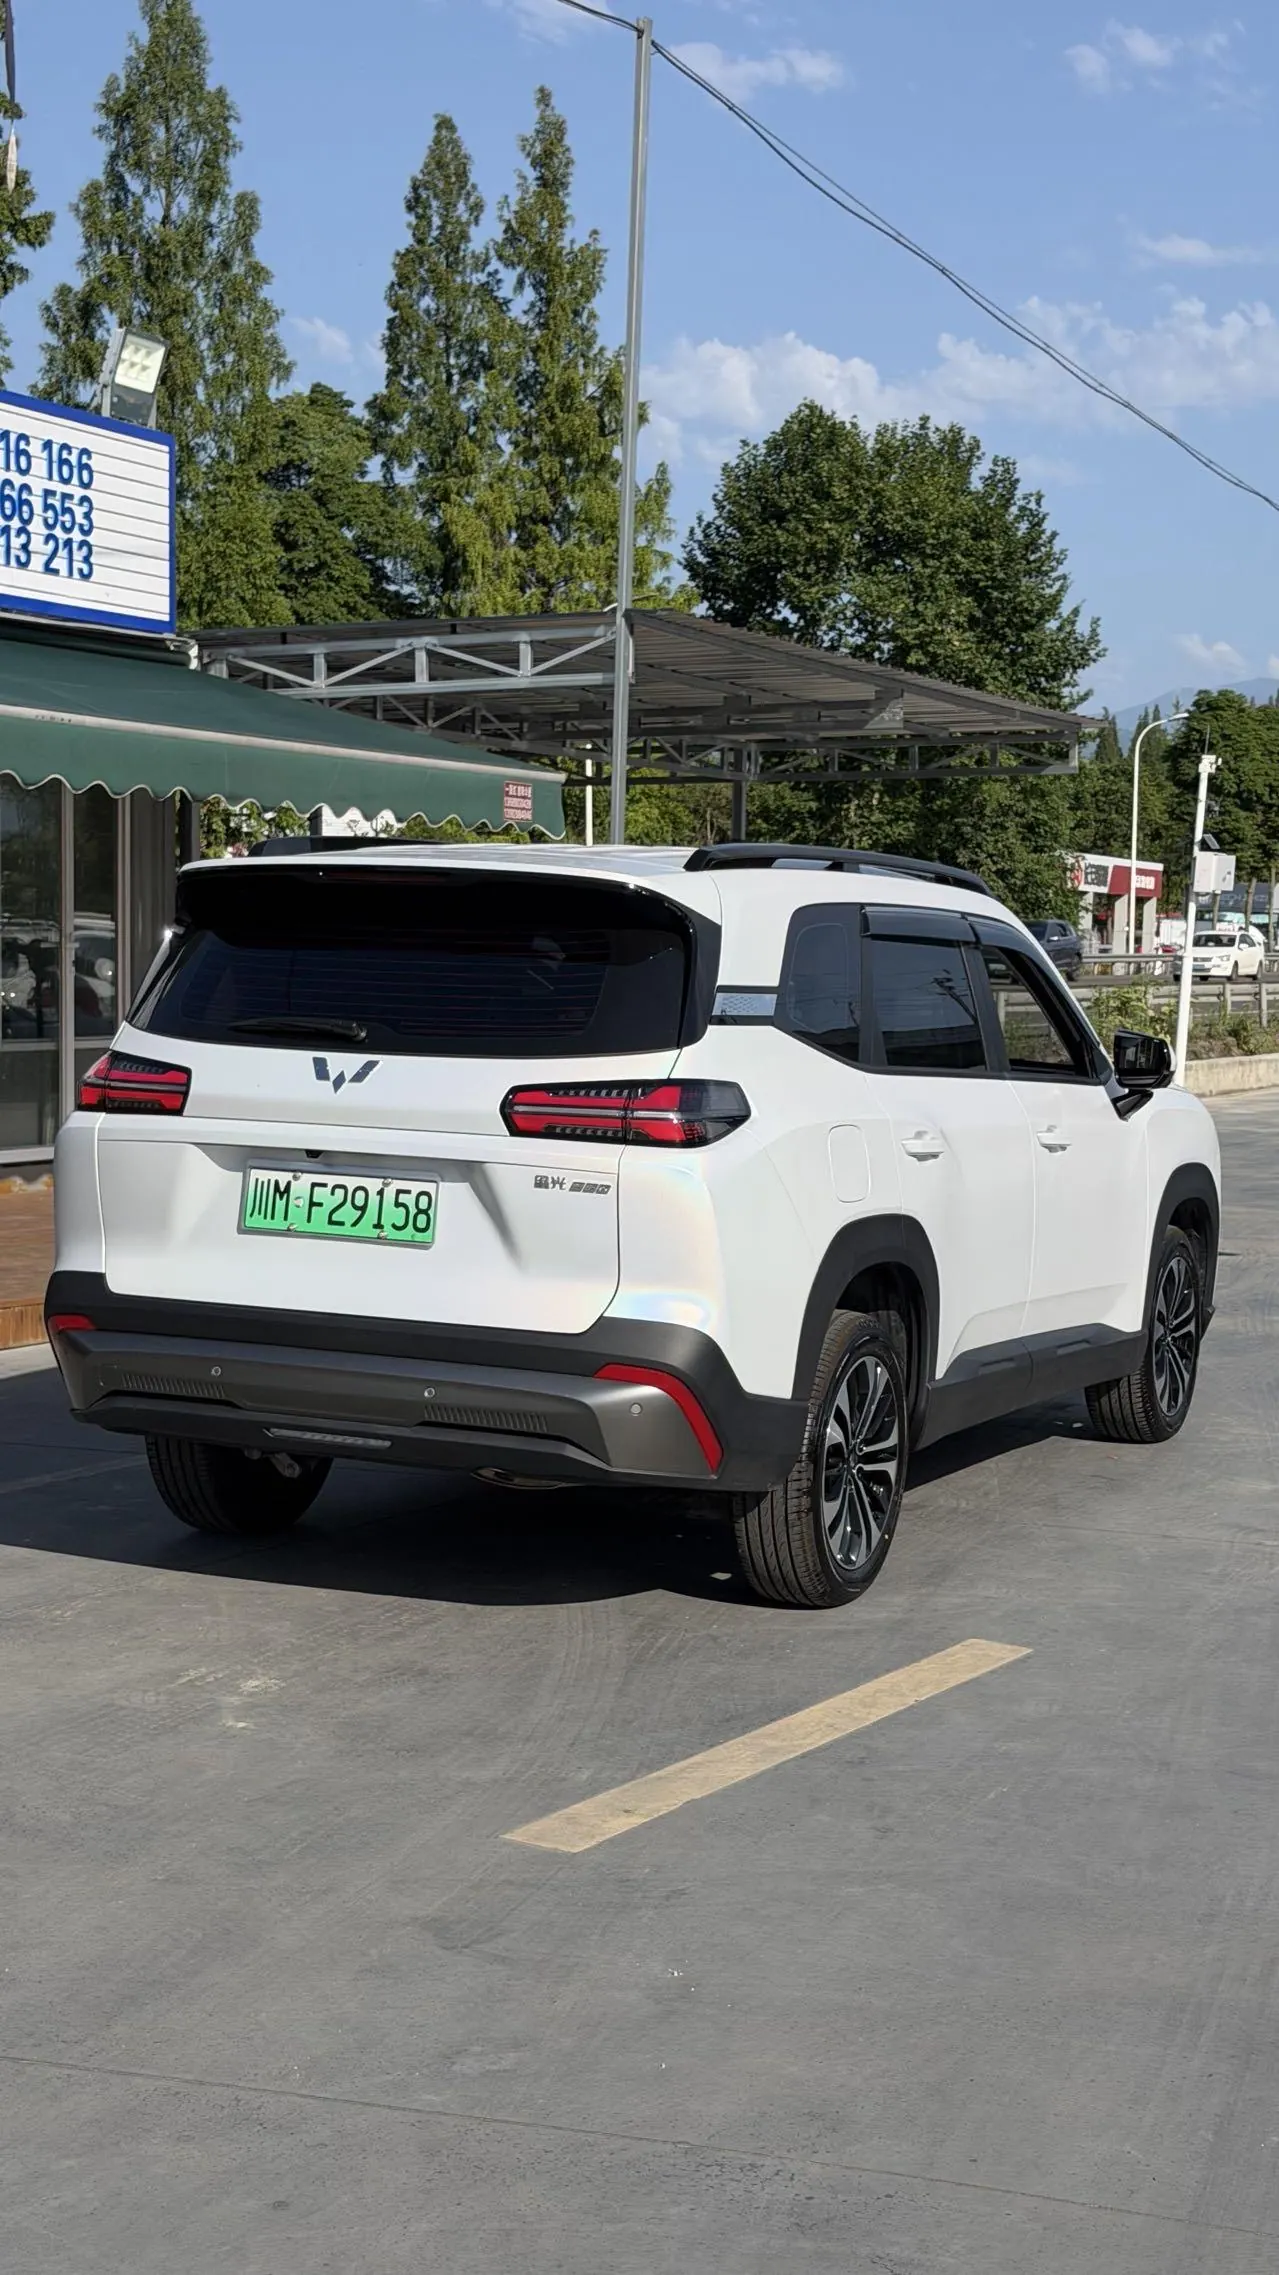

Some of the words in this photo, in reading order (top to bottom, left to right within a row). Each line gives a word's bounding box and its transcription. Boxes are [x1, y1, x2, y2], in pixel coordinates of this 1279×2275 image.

[0, 429, 32, 477] 16
[41, 439, 94, 490] 166
[0, 478, 34, 526] 66
[42, 488, 94, 537] 553
[0, 524, 32, 569] 13
[43, 533, 94, 580] 213
